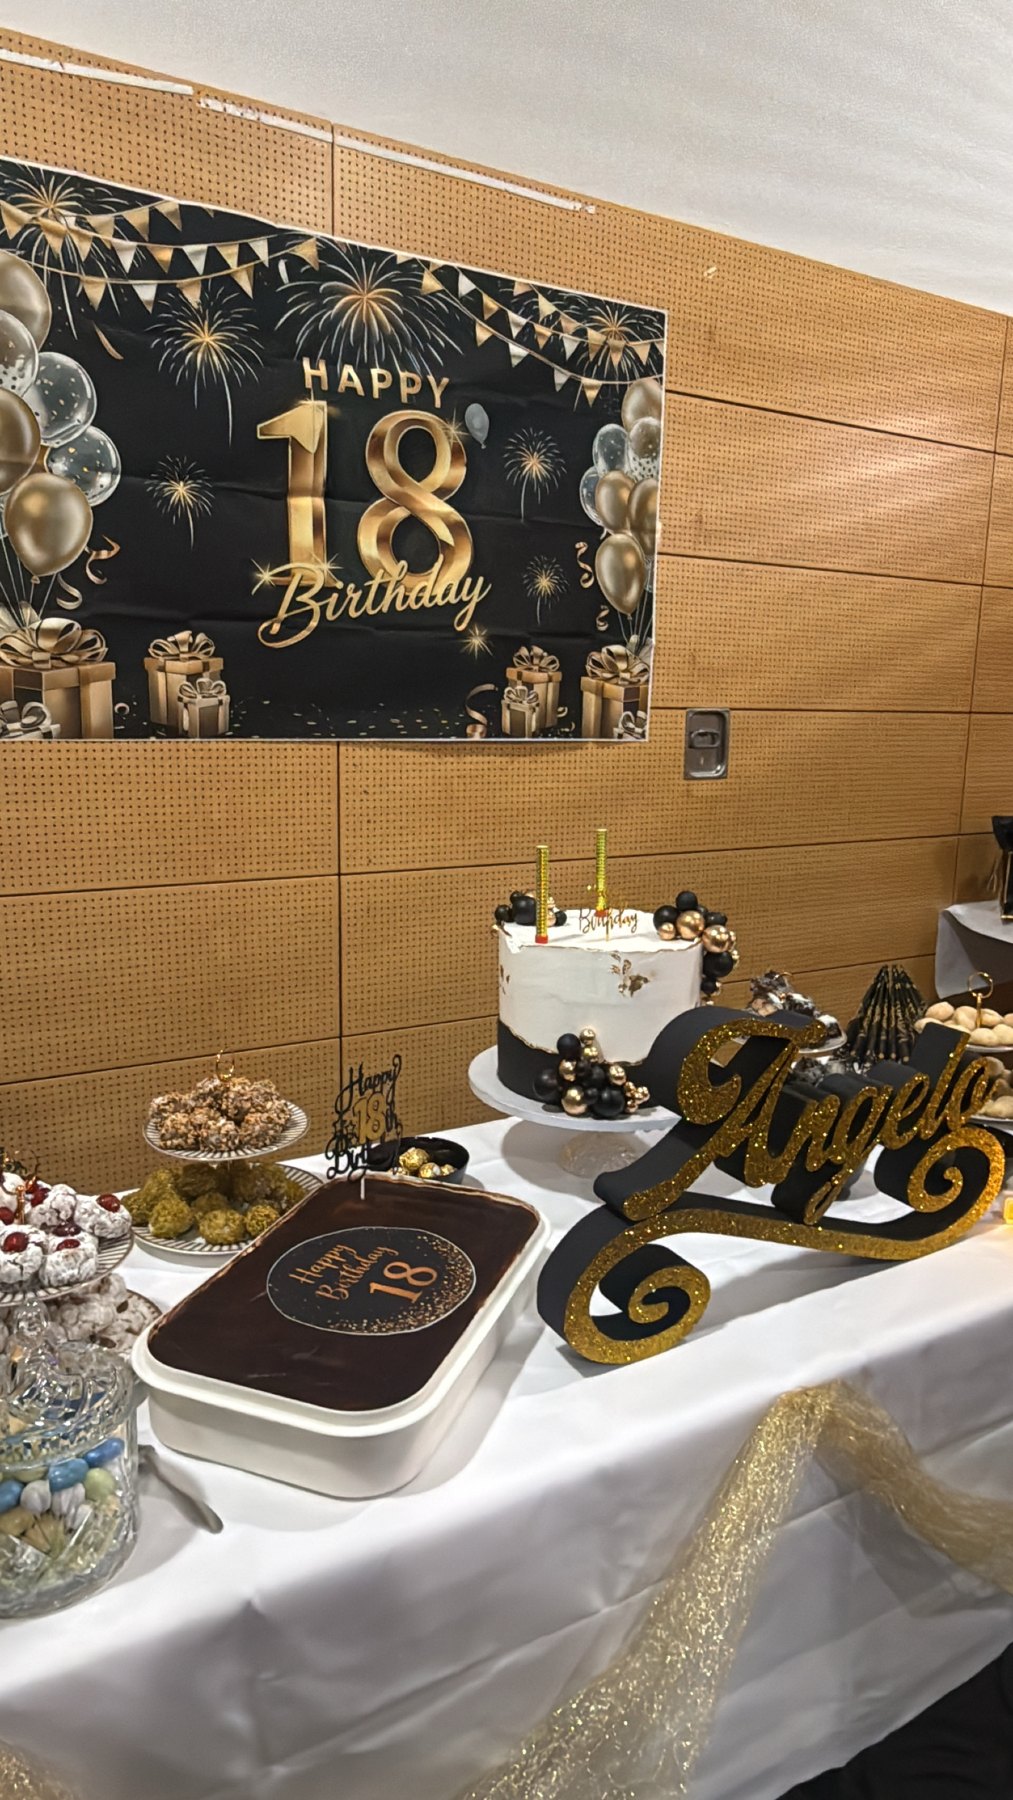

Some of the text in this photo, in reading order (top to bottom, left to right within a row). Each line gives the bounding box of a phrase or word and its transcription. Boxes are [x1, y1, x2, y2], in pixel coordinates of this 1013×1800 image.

[302, 357, 449, 409] HAPPY
[257, 400, 474, 598] 18
[257, 553, 492, 649] Birthday
[334, 1054, 402, 1114] Happy
[624, 1018, 1000, 1225] Angelo
[288, 1244, 357, 1285] Happy
[315, 1246, 399, 1300] Birthday
[369, 1261, 438, 1304] 18
